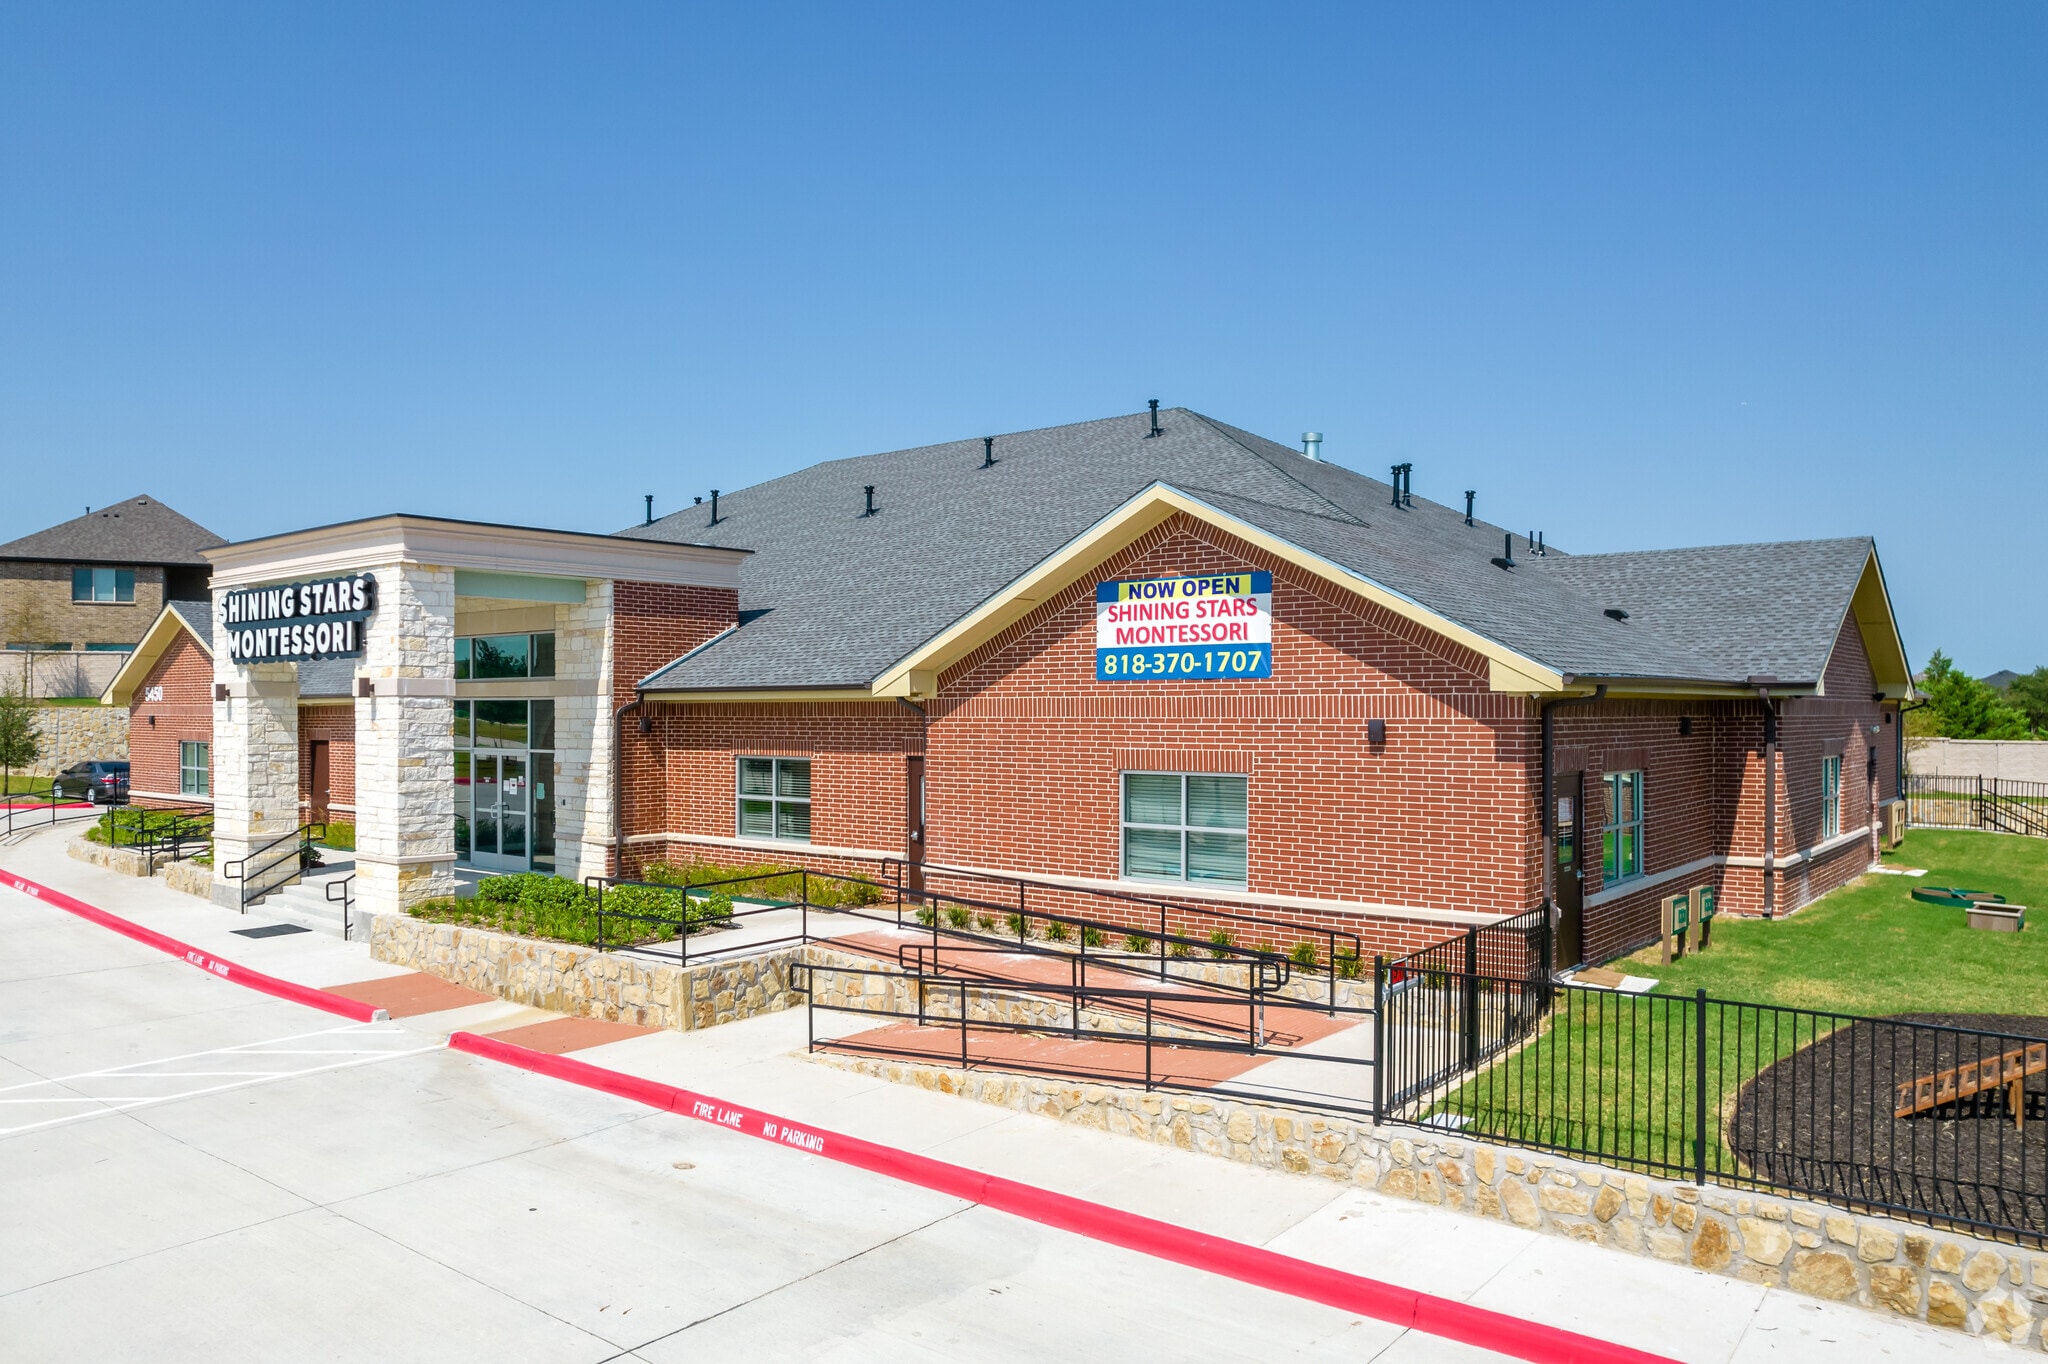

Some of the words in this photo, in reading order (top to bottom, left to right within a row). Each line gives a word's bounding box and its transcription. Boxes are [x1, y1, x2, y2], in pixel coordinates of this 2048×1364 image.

[218, 587, 294, 624] SHINING
[299, 578, 365, 616] STARS
[1128, 581, 1176, 600] NOW
[1182, 577, 1240, 597] OPEN
[1108, 601, 1190, 623] SHINING
[1196, 597, 1258, 618] STARS
[227, 620, 352, 659] MONTESSORI
[1115, 622, 1248, 645] MONTESSORI
[1104, 650, 1262, 675] 818-370-1707
[145, 685, 163, 702] 5450
[693, 1101, 716, 1120] FIRE
[717, 1108, 744, 1128] LANE
[762, 1121, 778, 1138] NO
[780, 1126, 824, 1152] PARKING
